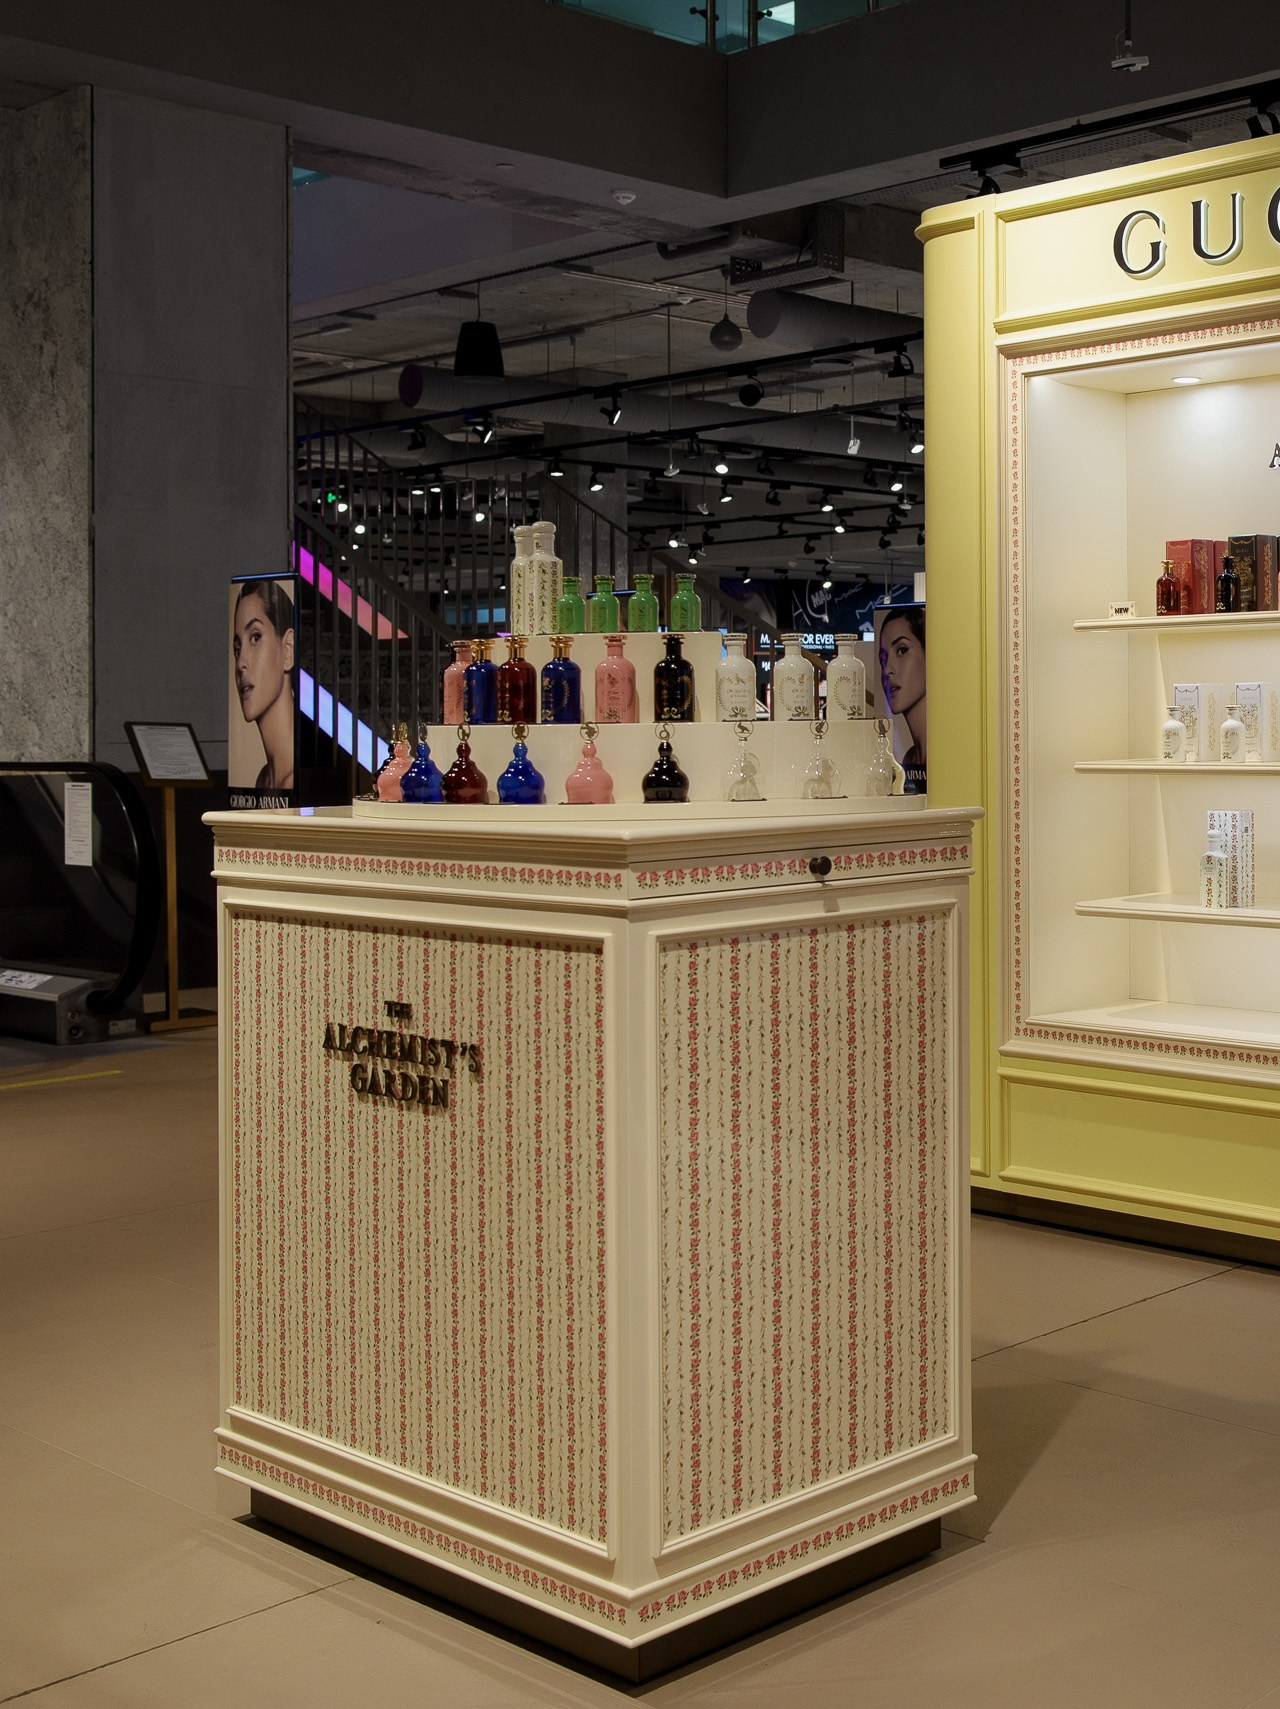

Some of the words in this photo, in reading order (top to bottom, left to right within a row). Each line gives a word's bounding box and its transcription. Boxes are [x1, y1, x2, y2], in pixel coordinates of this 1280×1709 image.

[815, 634, 835, 645] EVER
[906, 770, 927, 780] ARMA
[230, 794, 257, 808] GIORGIO
[258, 796, 289, 808] ARMANI
[384, 1000, 413, 1020] THE
[322, 1022, 482, 1073] ALCHEMIST'S
[350, 1063, 449, 1108] GARDEN
